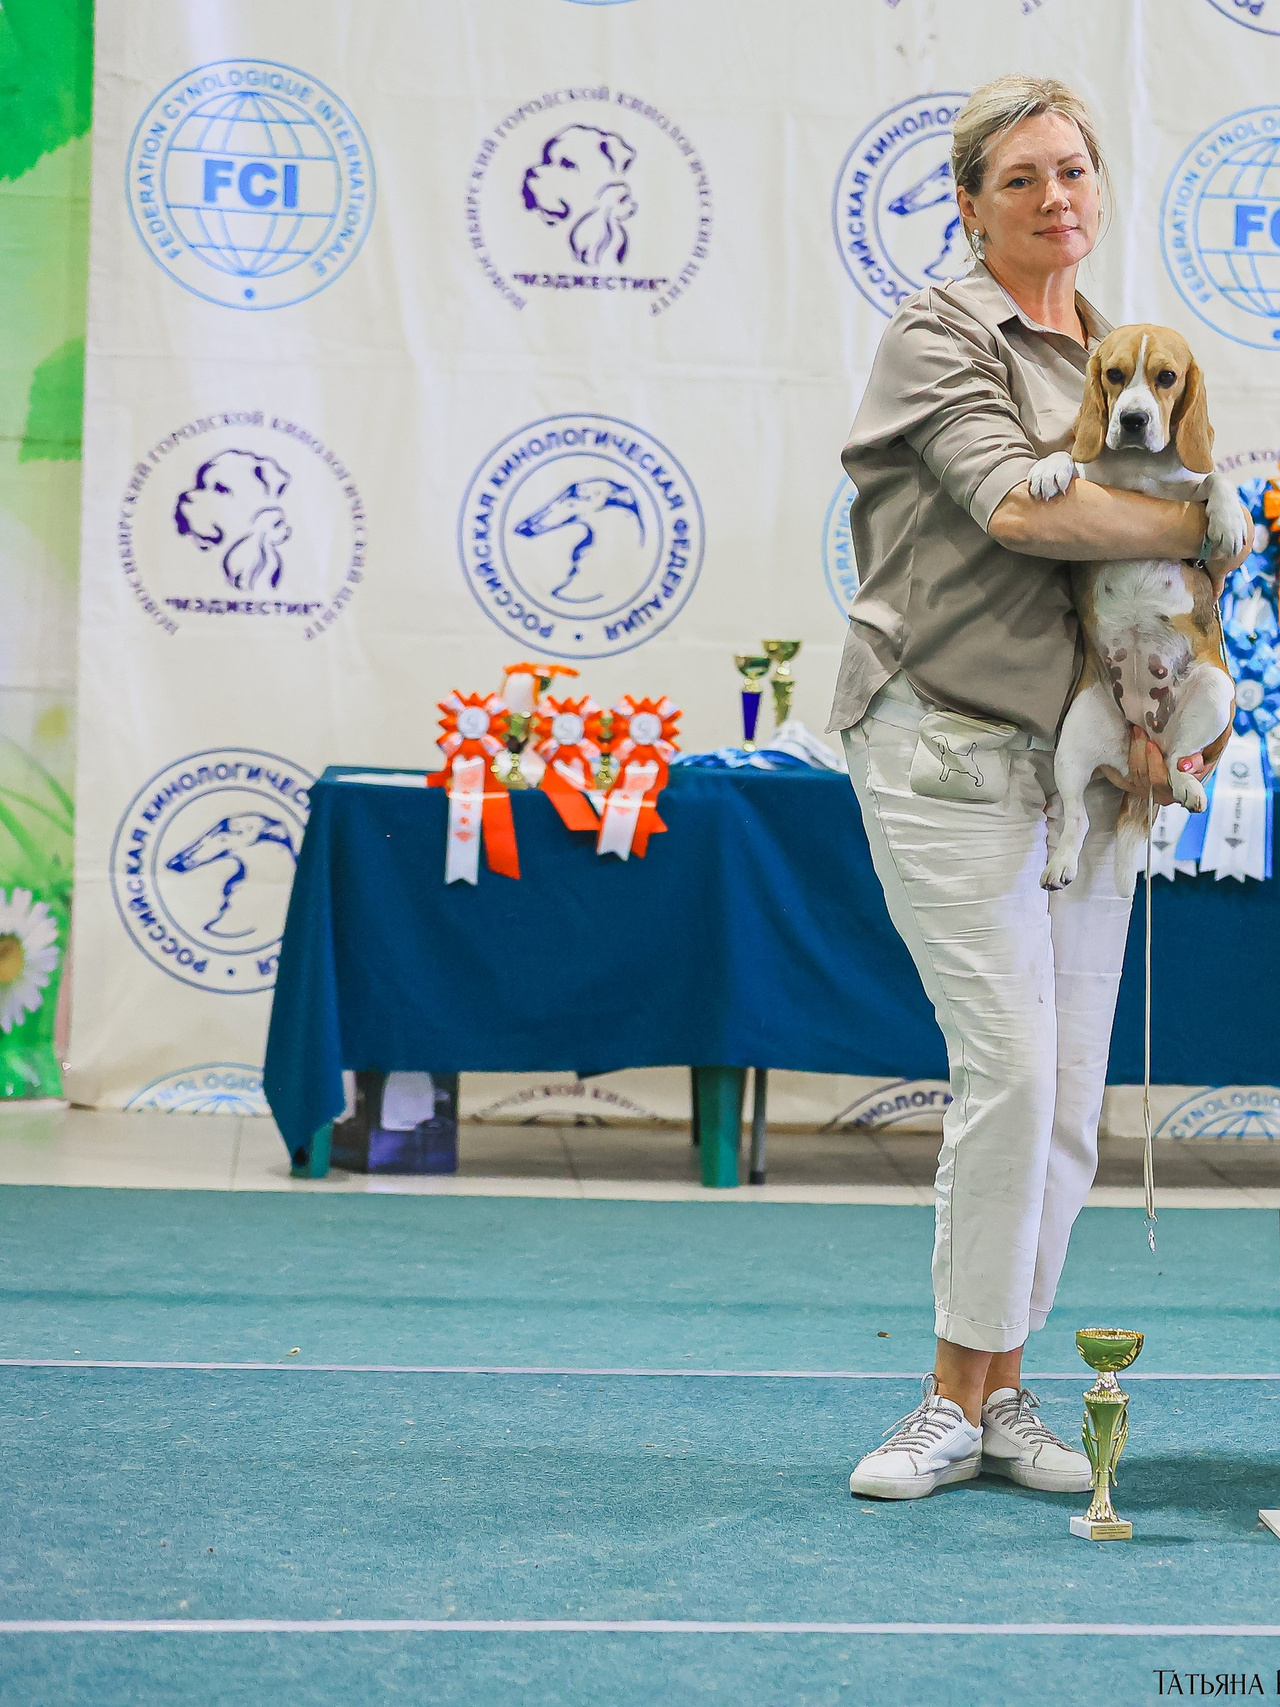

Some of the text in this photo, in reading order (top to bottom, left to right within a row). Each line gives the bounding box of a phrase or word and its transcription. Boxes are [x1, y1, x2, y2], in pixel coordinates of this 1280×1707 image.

[138, 69, 365, 277] FEDERATION CYNOLOGIQUE INTERNATIONALE
[203, 158, 298, 208] FCI
[1172, 169, 1213, 304] FEDERATION
[473, 427, 691, 641] РОССИЙСКАЯ КИНОЛОГИЧЕСКАЯ ФЕДЕРАЦИЯ
[126, 763, 312, 973] РОССИЙСКАЯ КИНОЛОГИЧЕС
